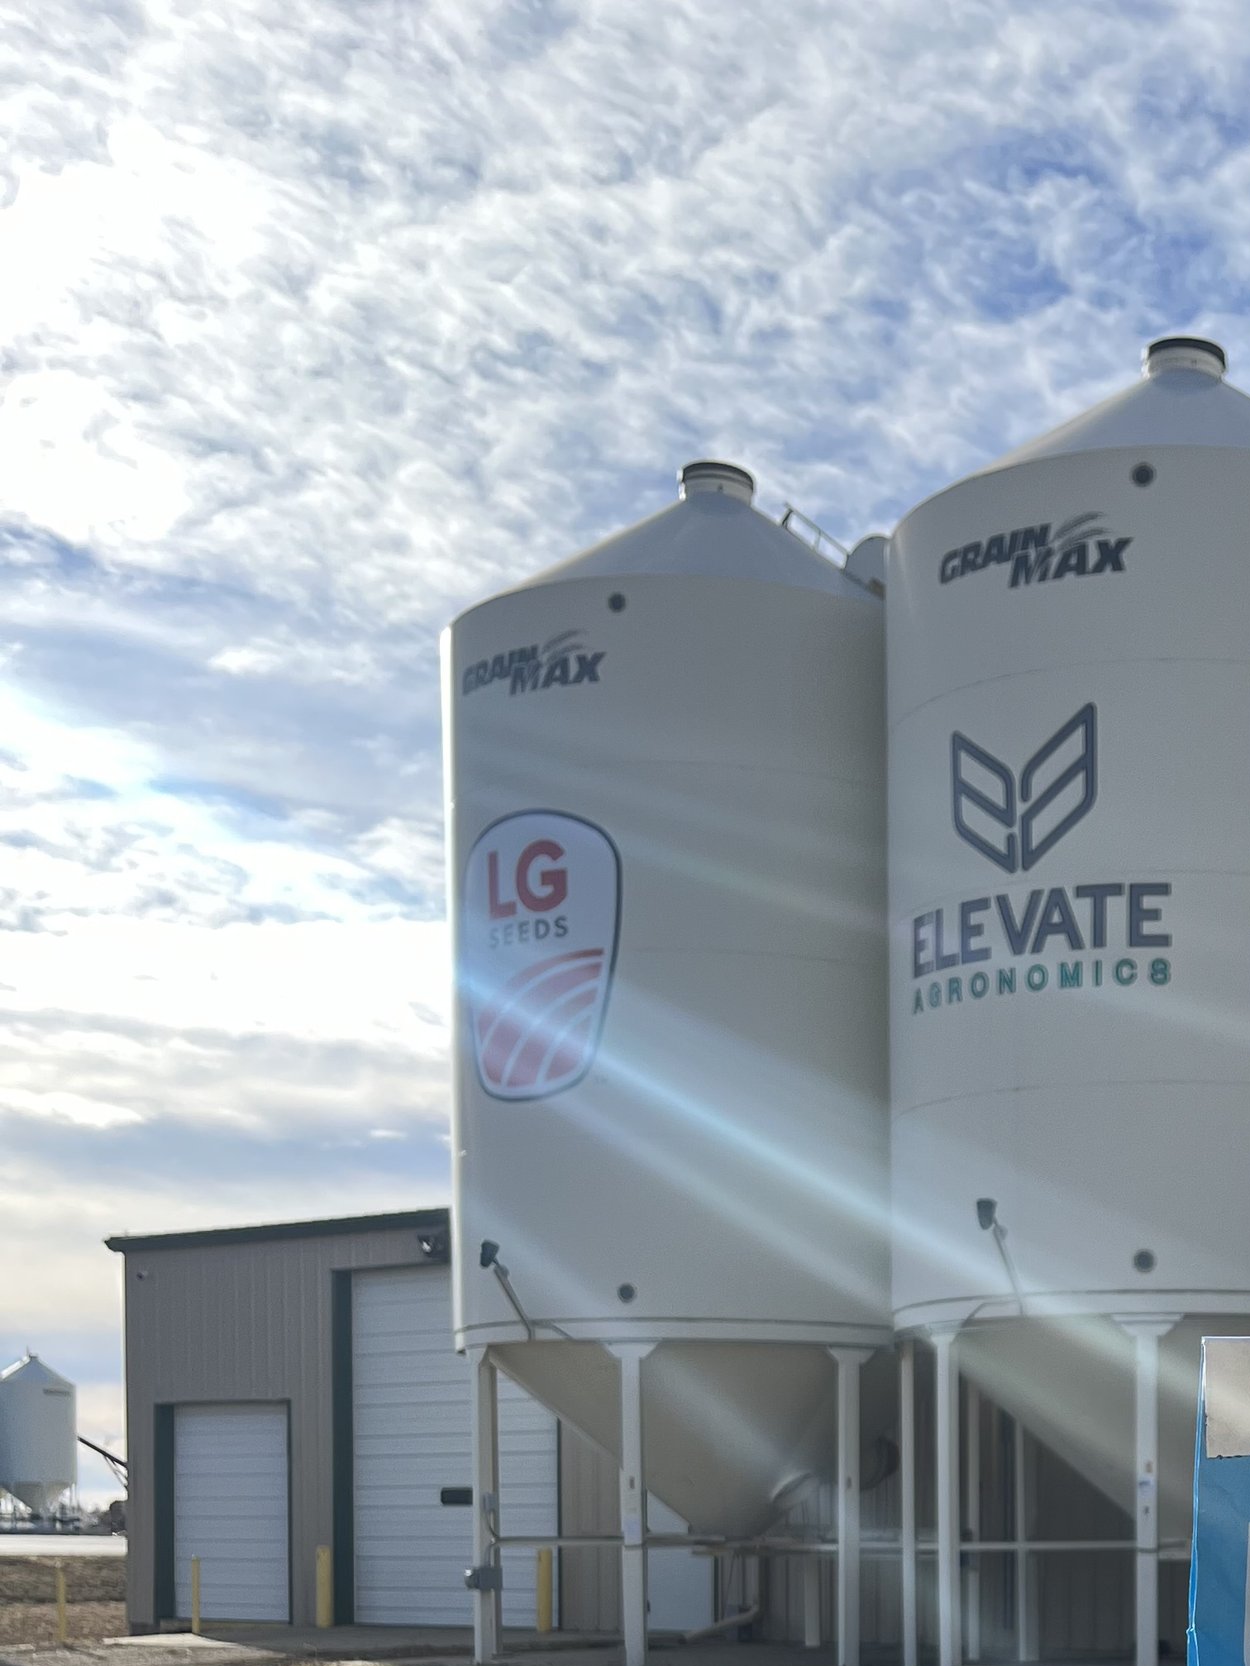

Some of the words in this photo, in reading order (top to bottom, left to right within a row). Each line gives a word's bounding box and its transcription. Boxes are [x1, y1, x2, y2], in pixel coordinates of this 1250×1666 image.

[939, 522, 1052, 584] GRAIN
[1008, 536, 1133, 588] MAX
[462, 644, 540, 697] GRAIN
[510, 651, 606, 697] MAX
[487, 839, 568, 919] LG
[488, 915, 568, 949] SEEDS
[911, 882, 1172, 979] ELEVATE
[912, 957, 1172, 1015] AGRONOMICS
